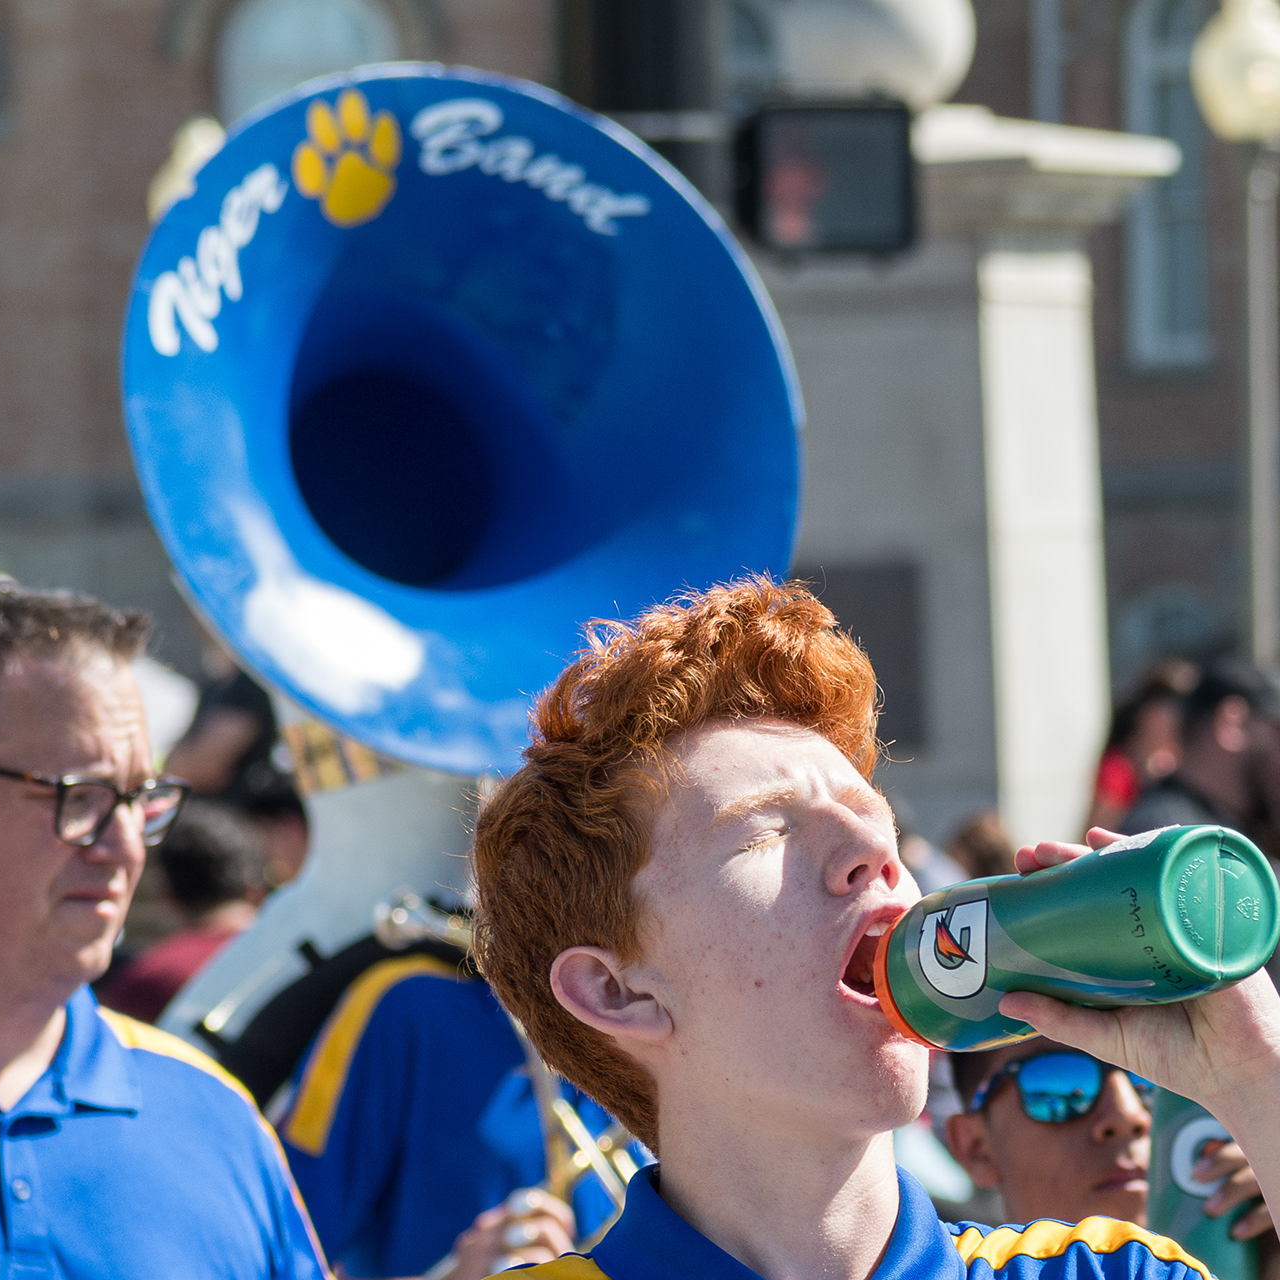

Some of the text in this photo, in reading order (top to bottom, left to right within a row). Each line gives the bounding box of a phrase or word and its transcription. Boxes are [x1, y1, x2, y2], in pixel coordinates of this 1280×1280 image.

[148, 98, 651, 357] Tiger Band
[919, 897, 989, 999] G
